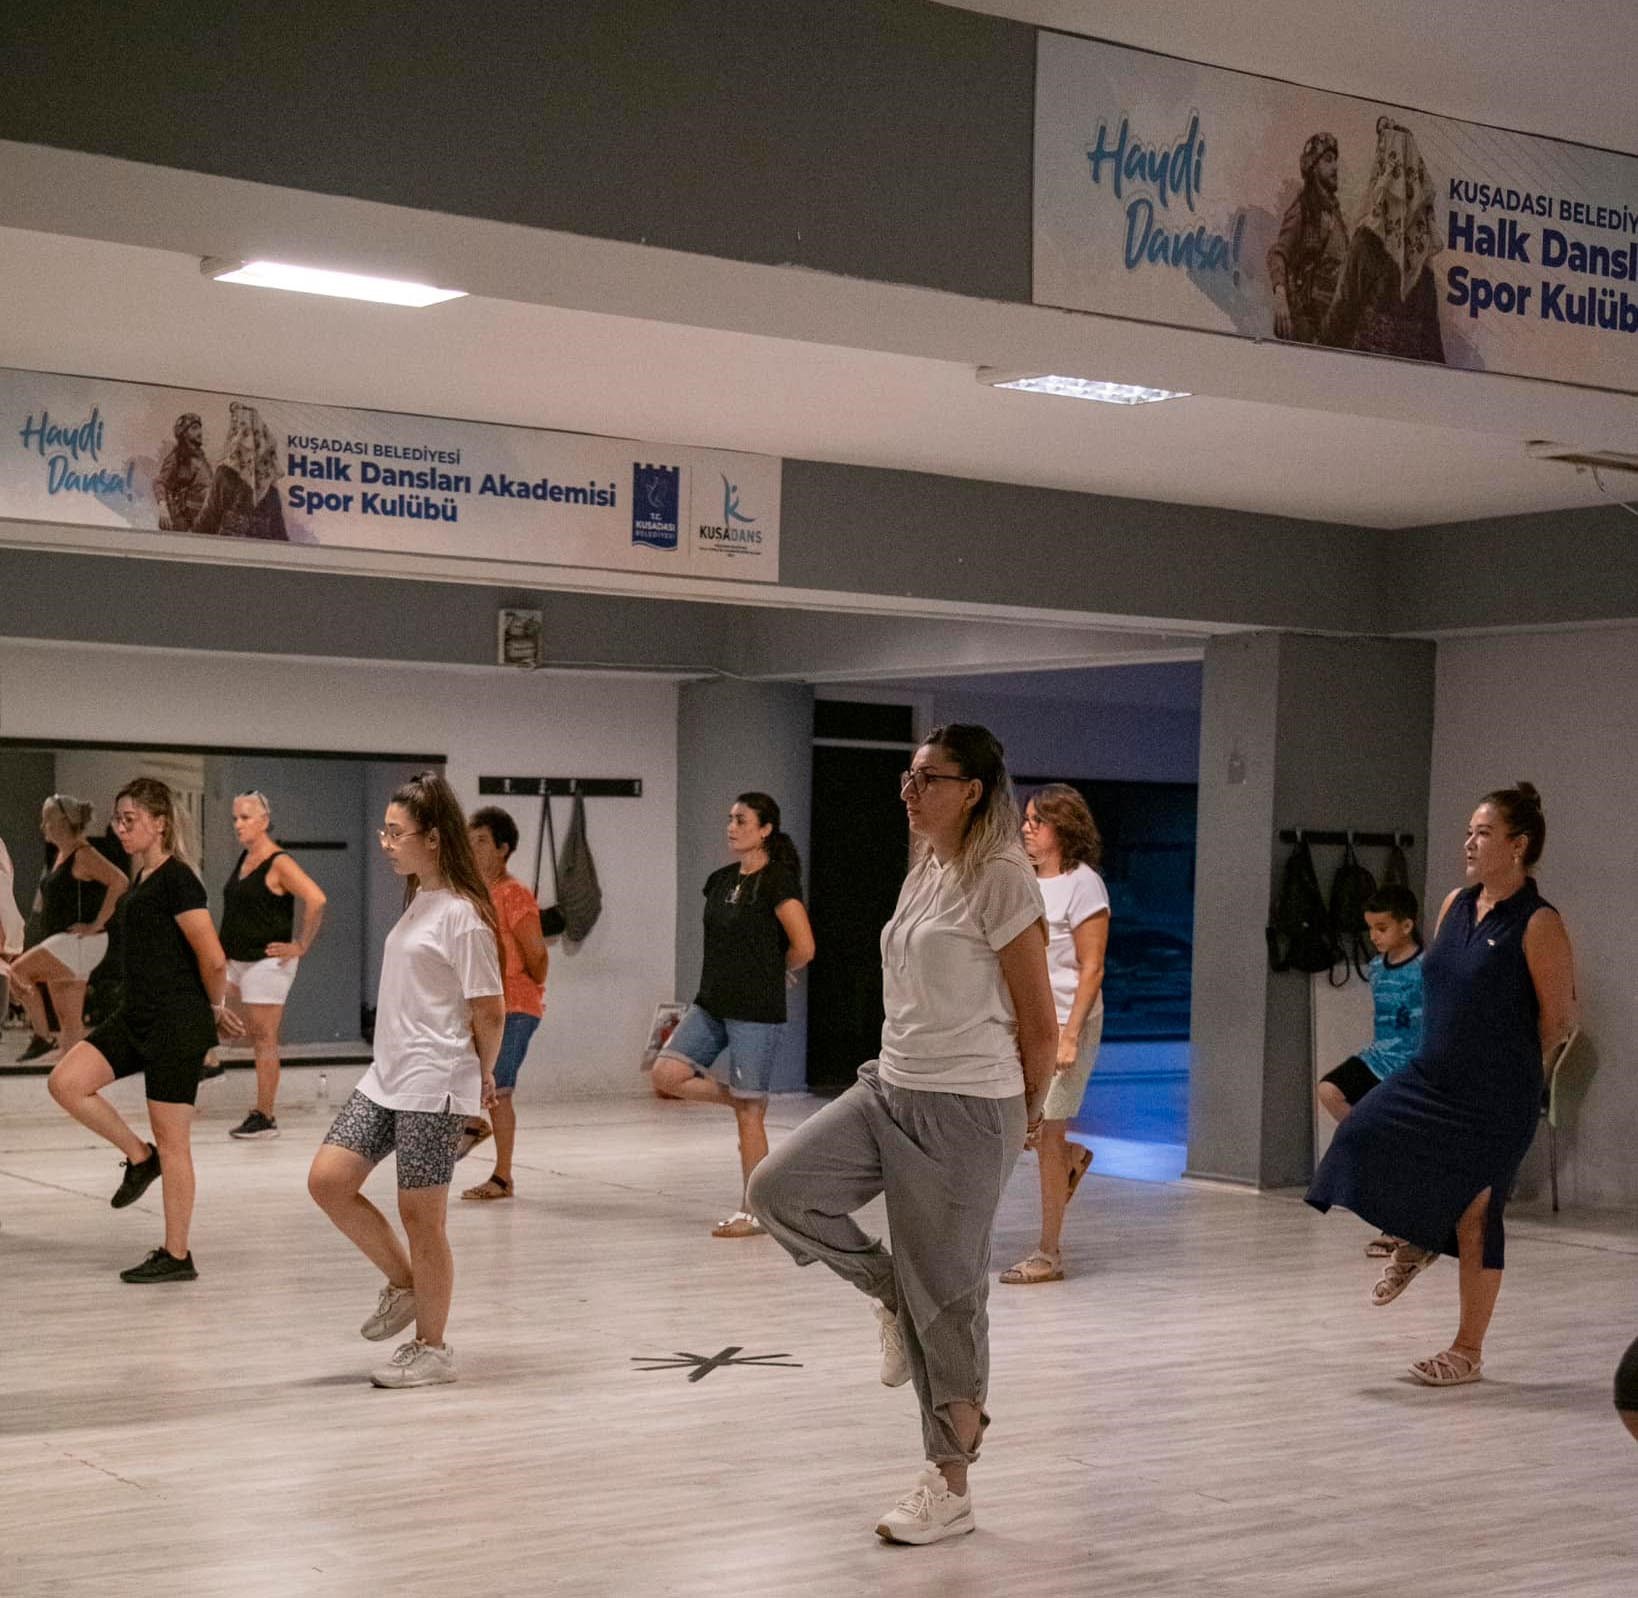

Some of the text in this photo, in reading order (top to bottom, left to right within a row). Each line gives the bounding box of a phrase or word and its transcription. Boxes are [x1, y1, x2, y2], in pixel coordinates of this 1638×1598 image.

[1087, 116, 1205, 212] Haydi
[1449, 178, 1553, 218] KUŞADASI
[1124, 198, 1246, 286] Dansa!
[1447, 210, 1638, 282] Halk Dansl
[1447, 265, 1638, 333] Spor Kulüb
[20, 408, 104, 461] Haydi
[287, 435, 460, 465] KUŞADASI BELEDİYESİ
[47, 456, 135, 502] Dansa!
[287, 454, 617, 508] Halk Dansları Akademisi
[287, 484, 458, 522] Spor Kulübü
